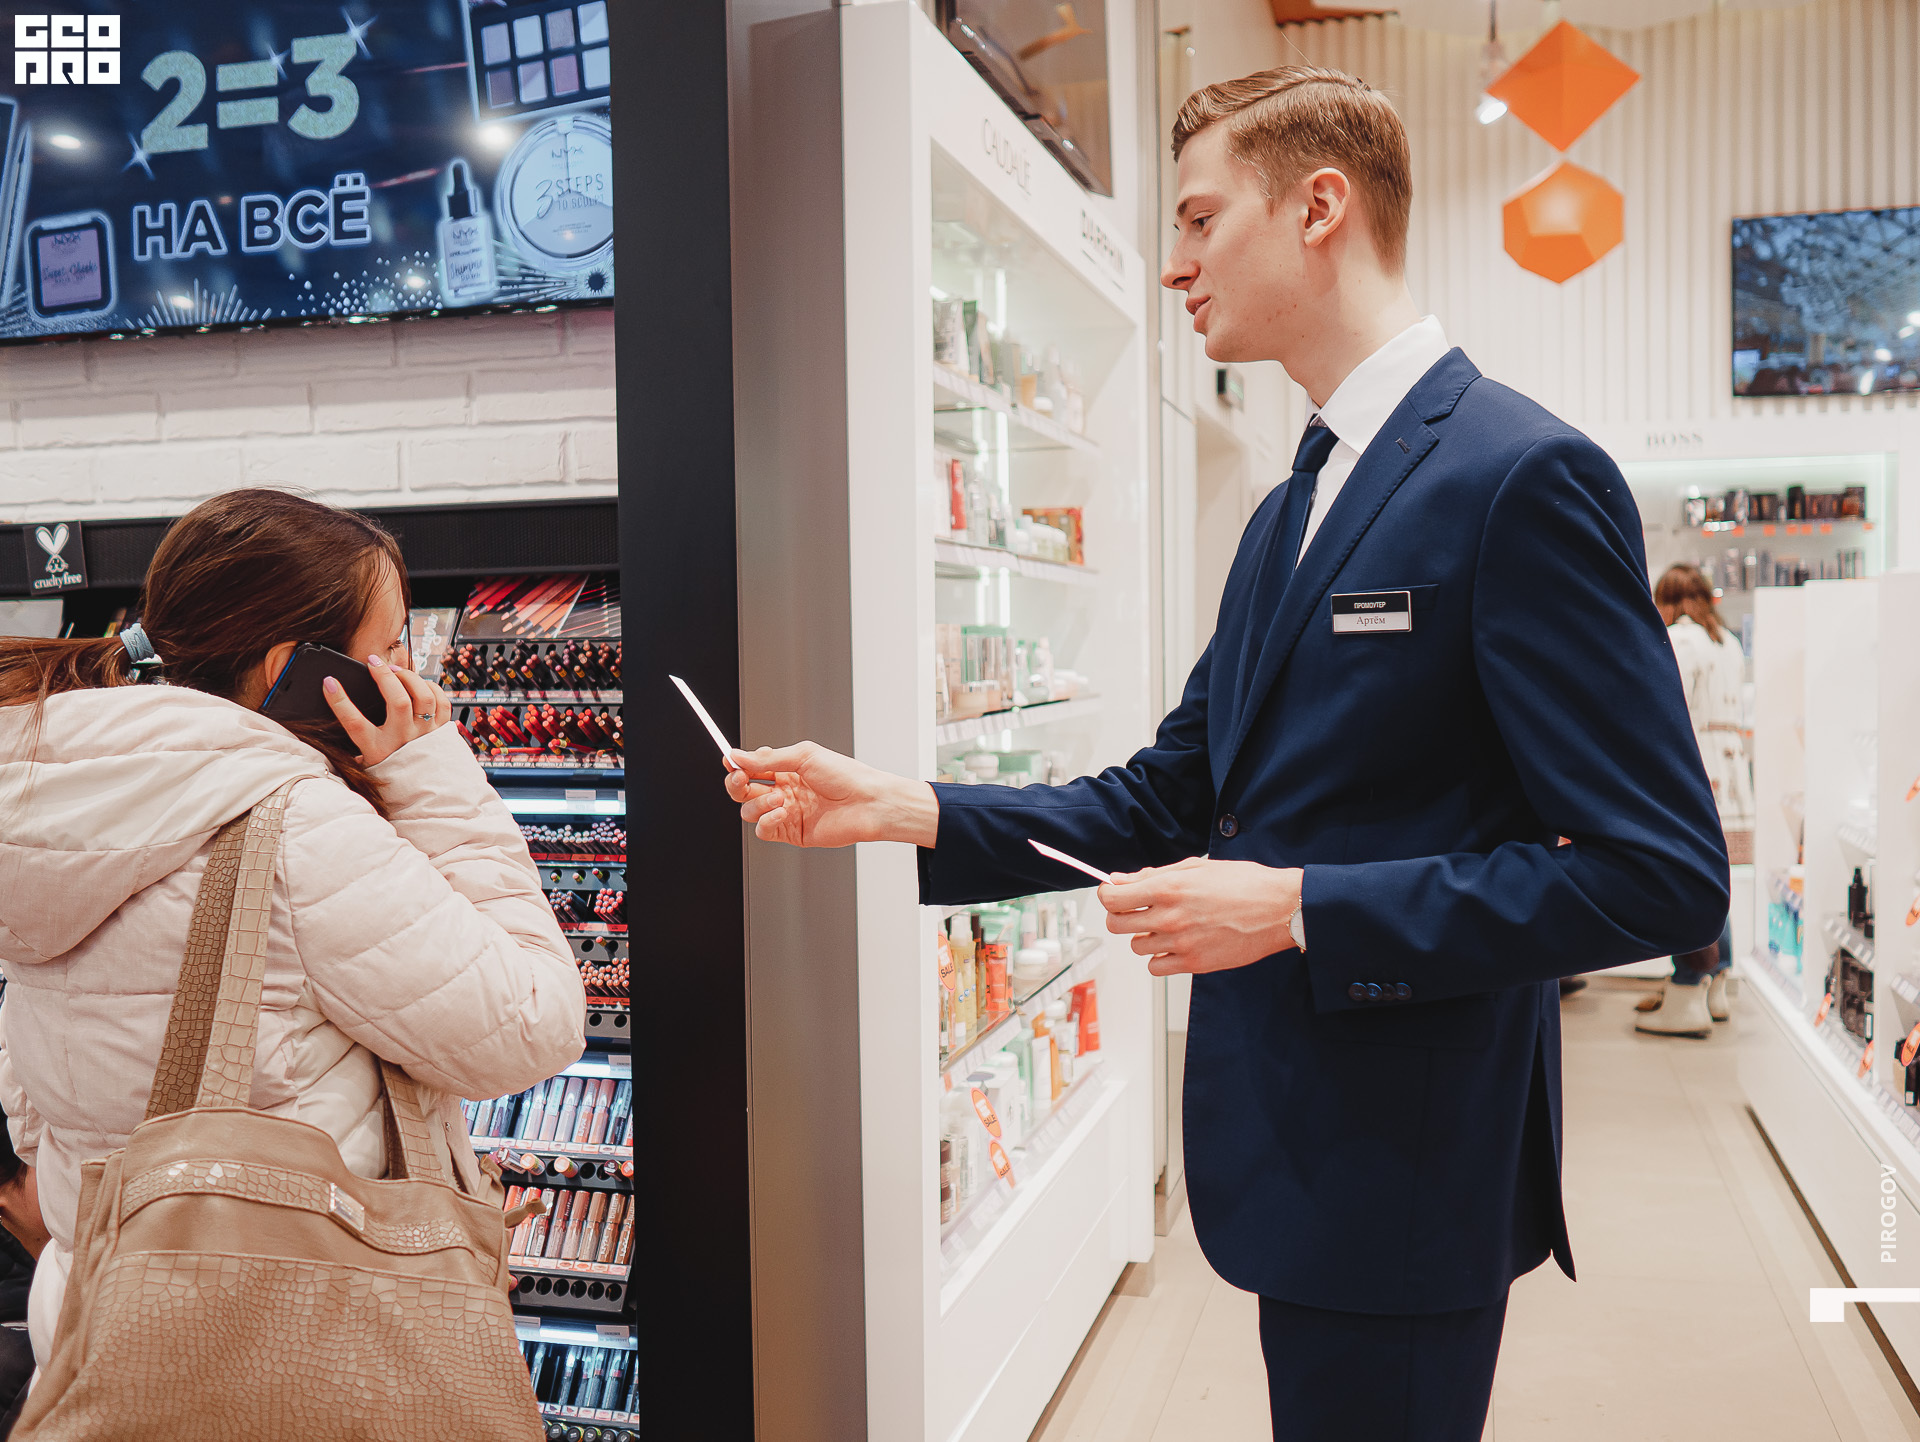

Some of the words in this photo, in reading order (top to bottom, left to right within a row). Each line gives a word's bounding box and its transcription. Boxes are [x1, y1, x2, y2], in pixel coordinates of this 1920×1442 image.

[141, 32, 360, 155] 2=3
[556, 173, 604, 197] STEPS
[133, 199, 229, 262] НА
[240, 172, 372, 253] ВСЁ
[1356, 615, 1386, 627] Артём
[940, 962, 954, 978] SALE
